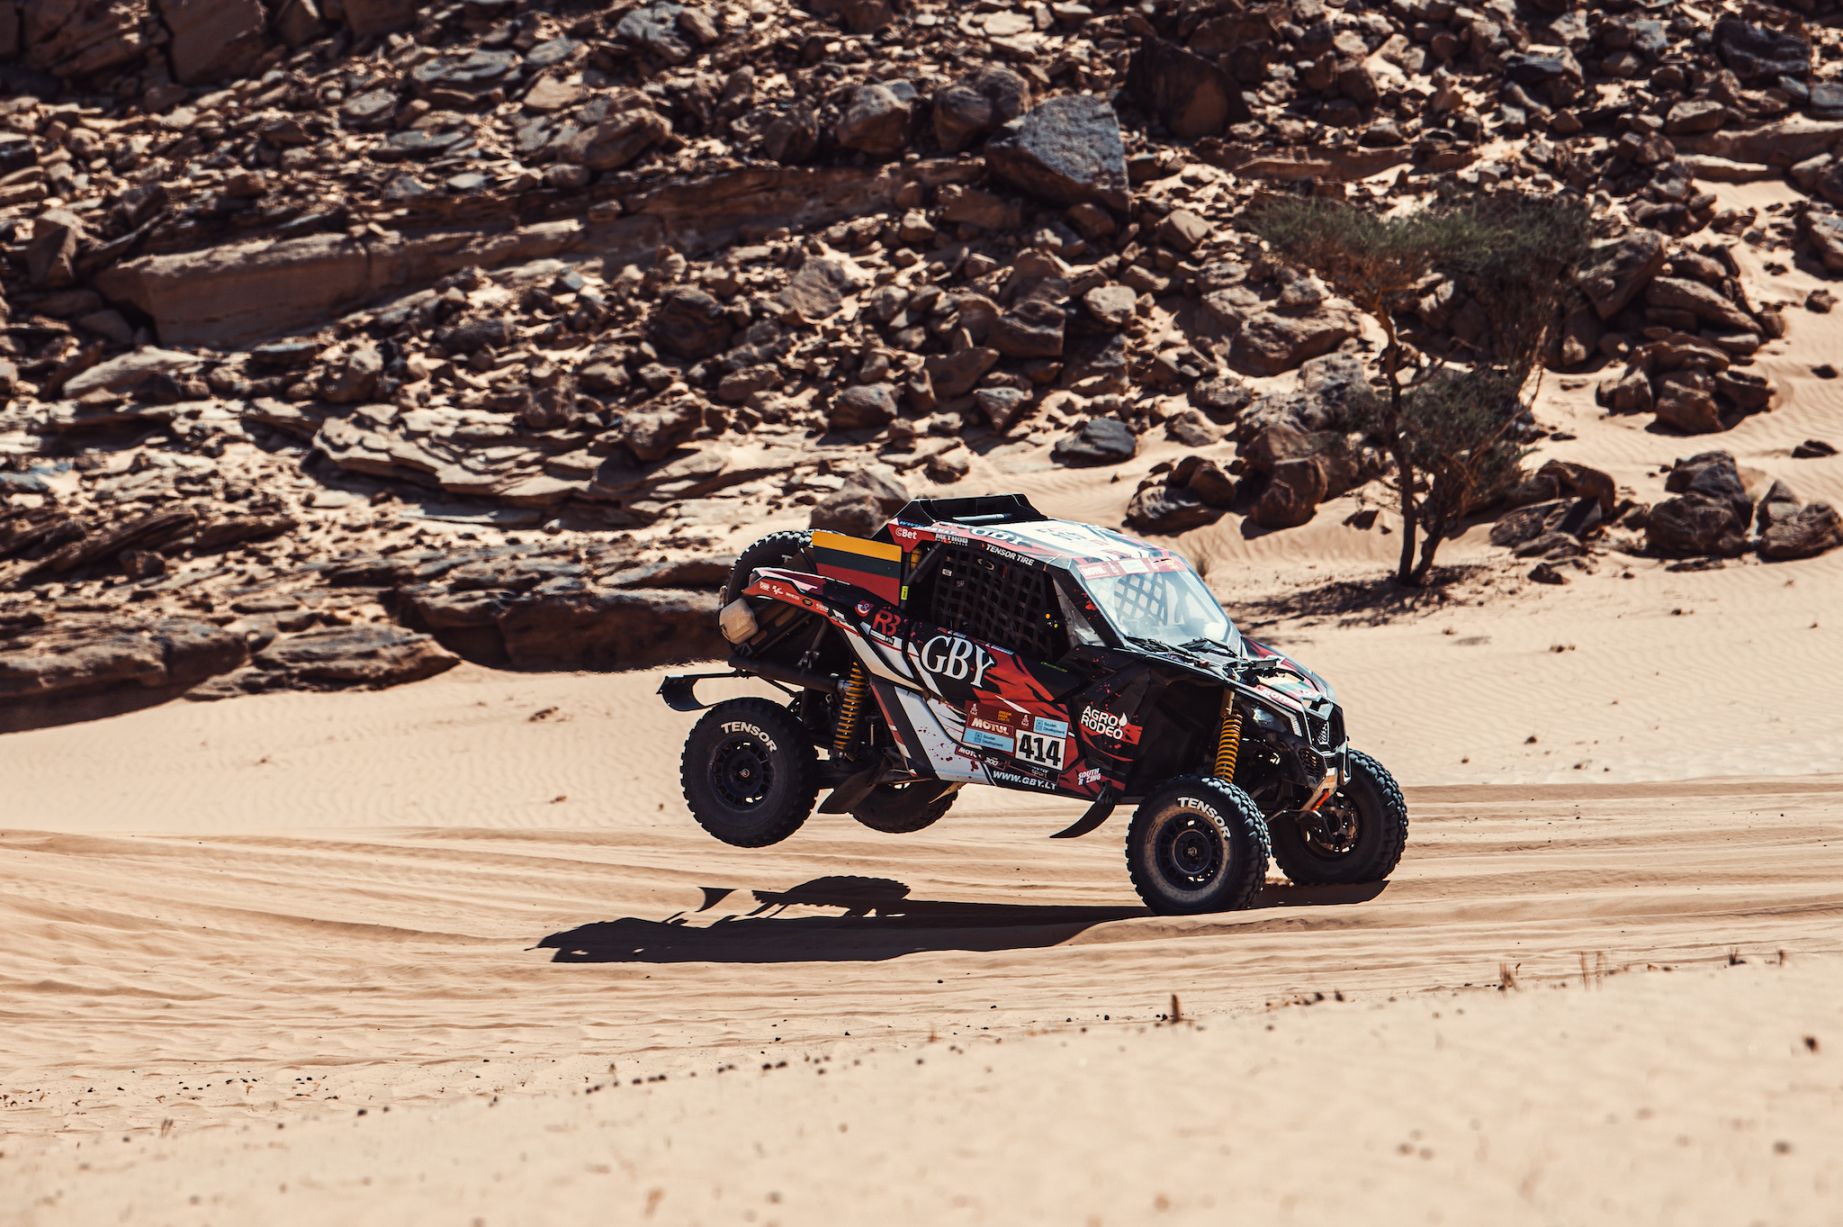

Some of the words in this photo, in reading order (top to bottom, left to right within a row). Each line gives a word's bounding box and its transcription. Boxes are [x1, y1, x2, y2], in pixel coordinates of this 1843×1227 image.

[895, 527, 918, 540] CBet
[986, 543, 1016, 561] TENSOR
[1017, 555, 1035, 567] TIRE
[872, 610, 901, 636] R3
[921, 635, 995, 688] GBY
[971, 718, 1010, 736] MOTUL
[1081, 715, 1123, 740] RODEO
[1083, 705, 1119, 727] AGRO
[720, 721, 778, 752] TENSOR
[1018, 734, 1062, 767] 414
[993, 770, 1058, 790] WWW.GBY.LT
[1078, 768, 1100, 779] SOUTH
[1177, 796, 1232, 839] TENSOR
